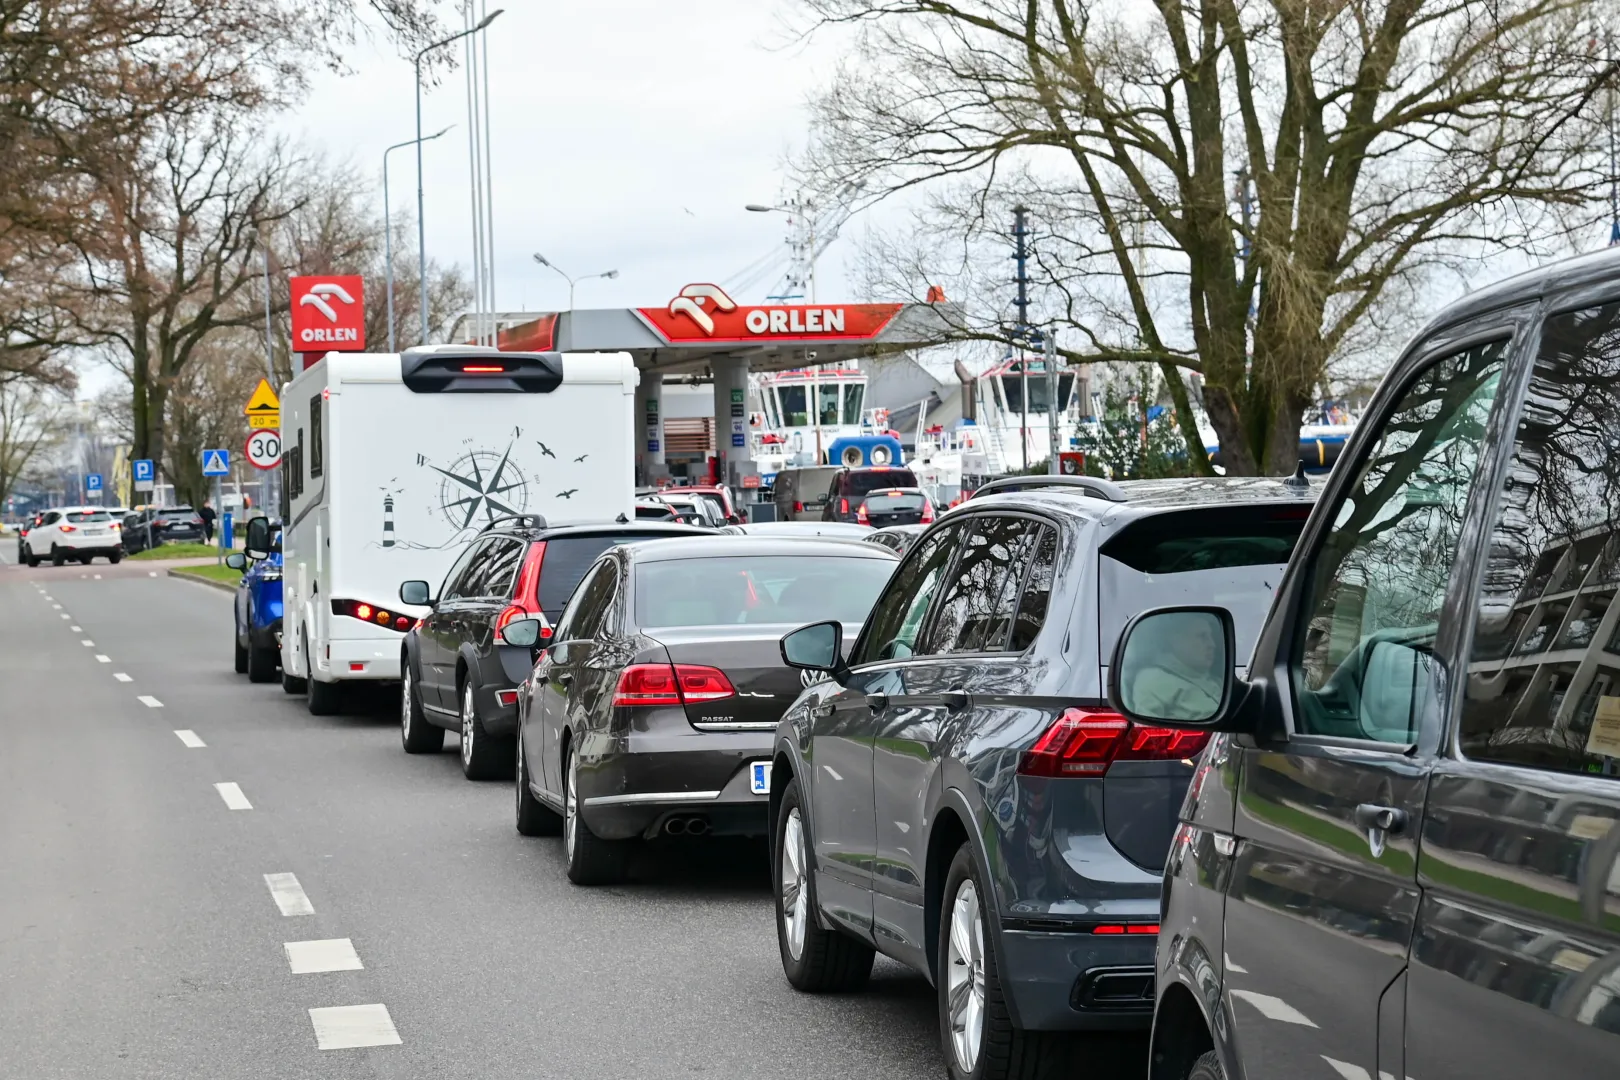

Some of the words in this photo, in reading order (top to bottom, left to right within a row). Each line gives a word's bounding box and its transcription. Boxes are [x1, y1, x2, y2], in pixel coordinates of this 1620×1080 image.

[745, 309, 845, 333] ORLEN
[301, 328, 357, 342] ORLEN
[254, 417, 265, 426] 20
[252, 439, 279, 458] 30
[136, 462, 149, 479] P
[89, 476, 99, 489] P
